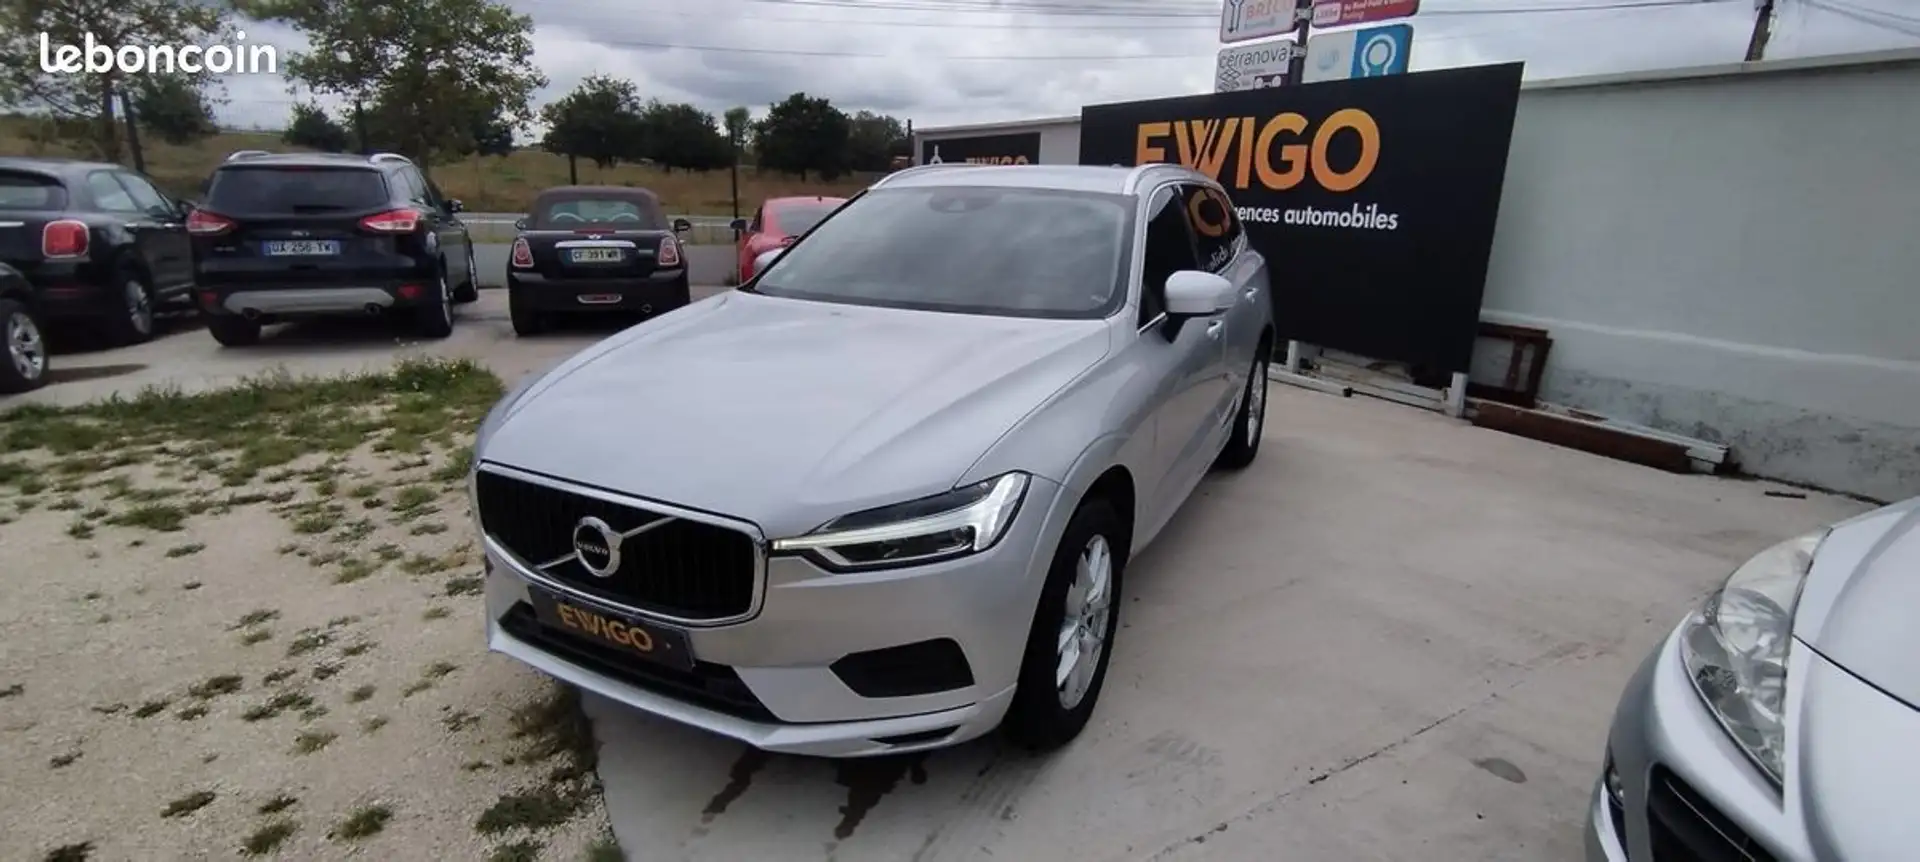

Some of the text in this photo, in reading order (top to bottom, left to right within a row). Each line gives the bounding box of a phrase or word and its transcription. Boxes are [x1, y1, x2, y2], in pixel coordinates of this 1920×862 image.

[1136, 108, 1381, 191] EWIGO
[1284, 202, 1399, 231] automobiles
[576, 541, 609, 556] VOLVO
[556, 603, 653, 651] EWIGO
